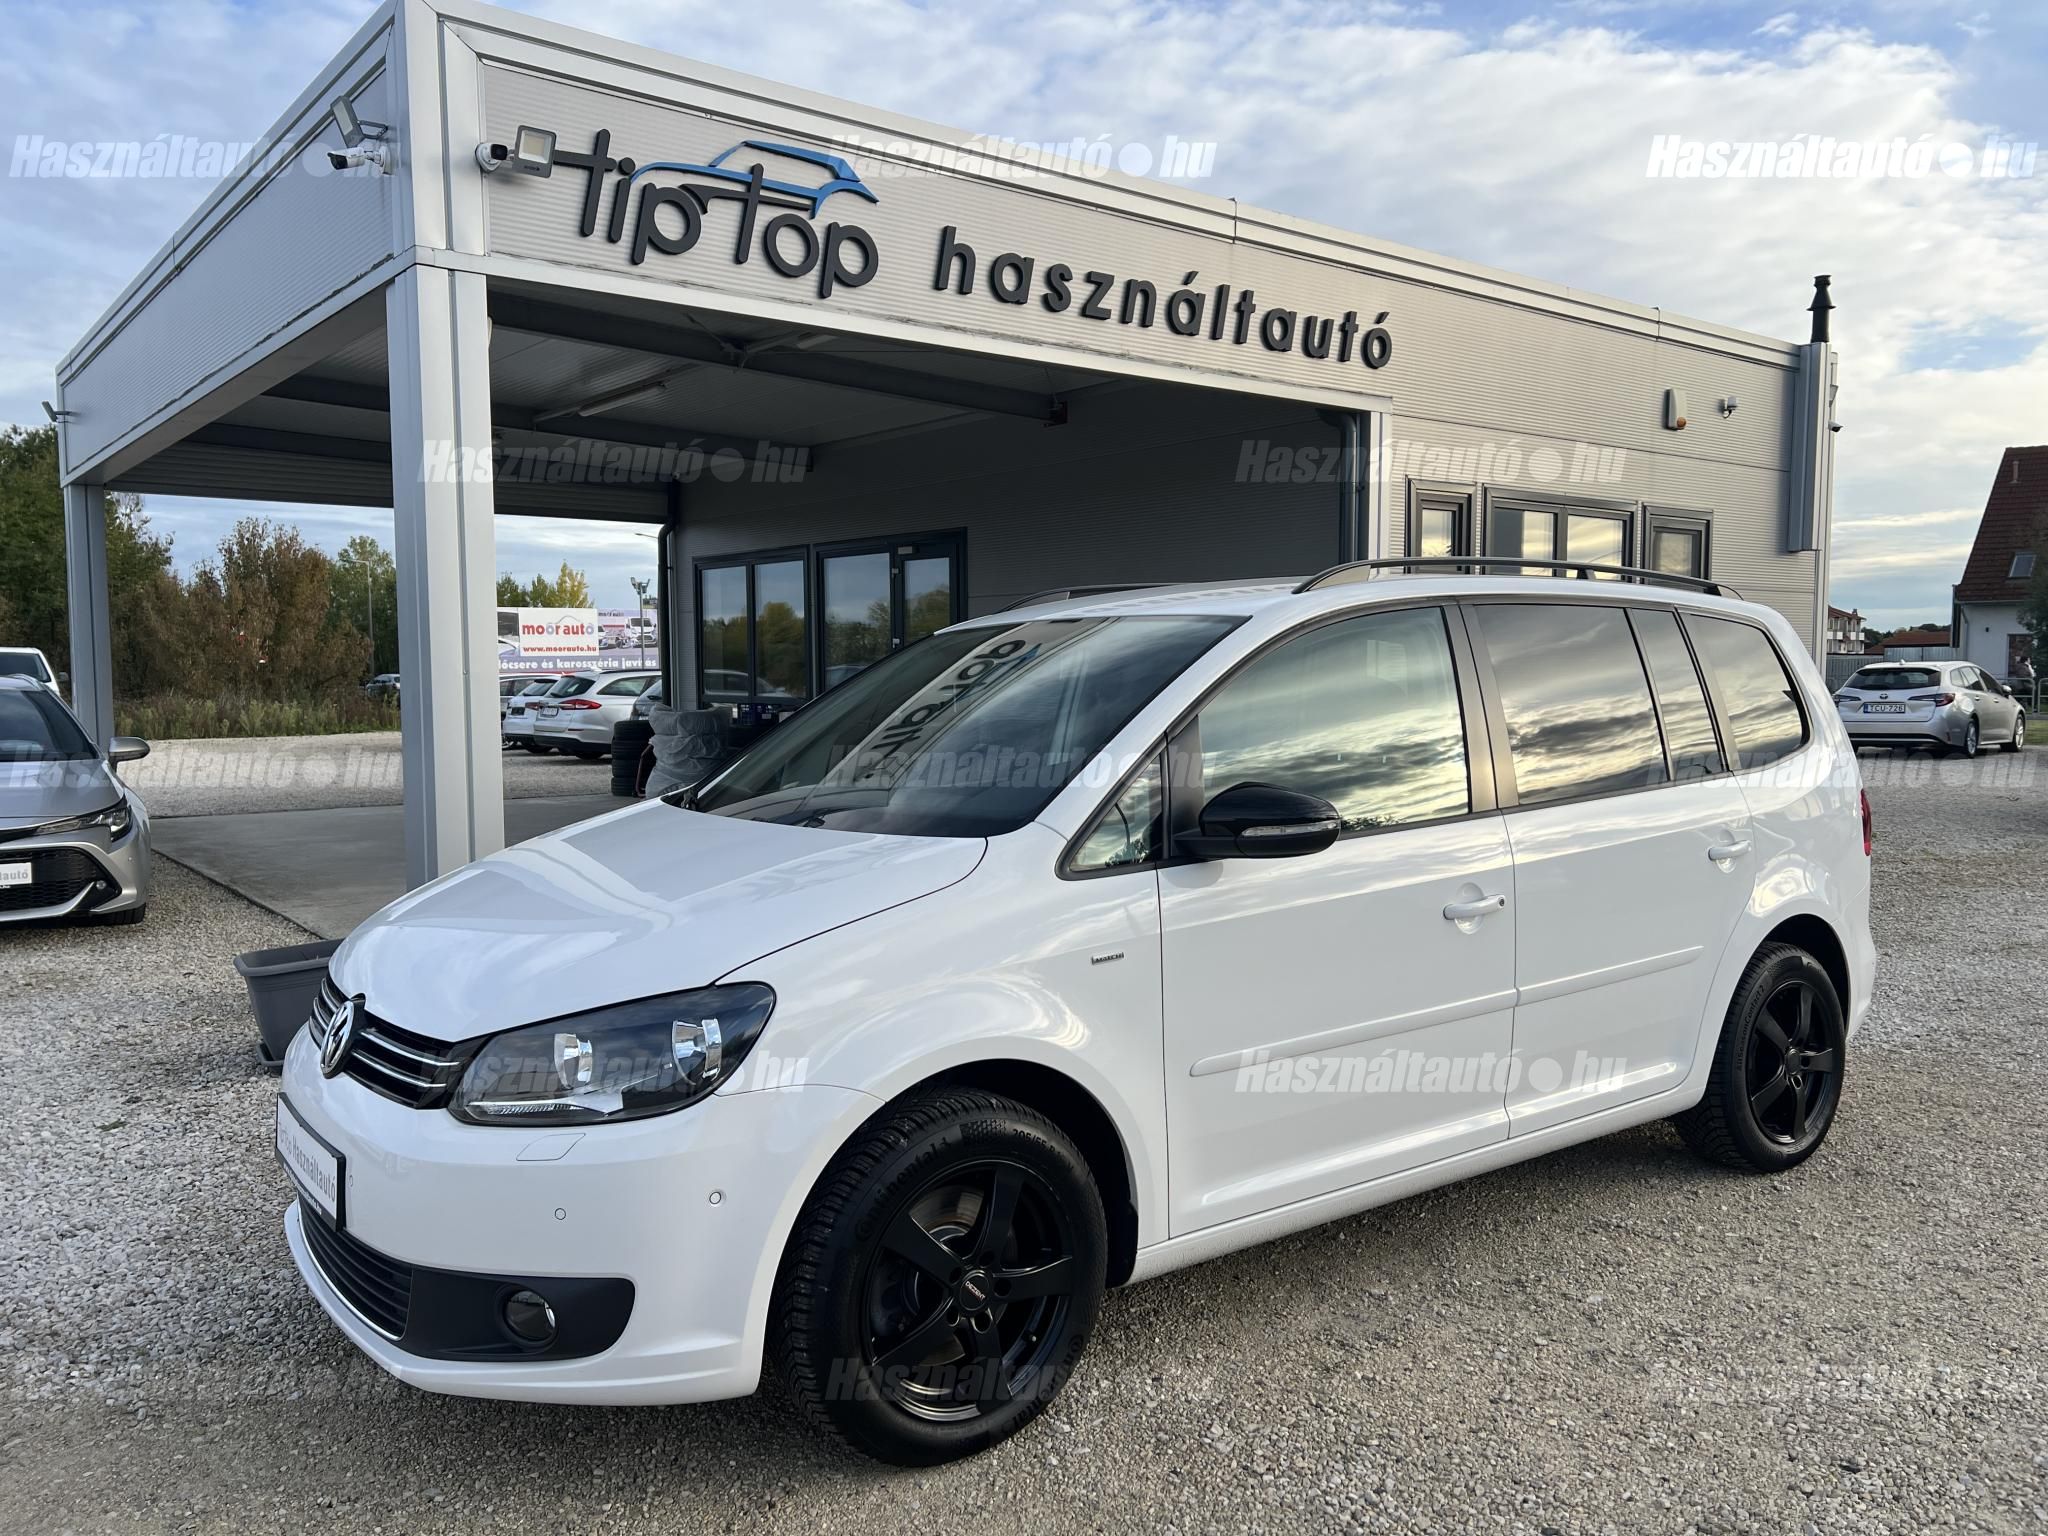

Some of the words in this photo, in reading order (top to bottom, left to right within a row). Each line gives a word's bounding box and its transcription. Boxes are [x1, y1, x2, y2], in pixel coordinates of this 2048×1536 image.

[935, 225, 1393, 369] használtautó
[523, 645, 597, 653] www.moorauto.hu
[621, 657, 657, 669] javíás
